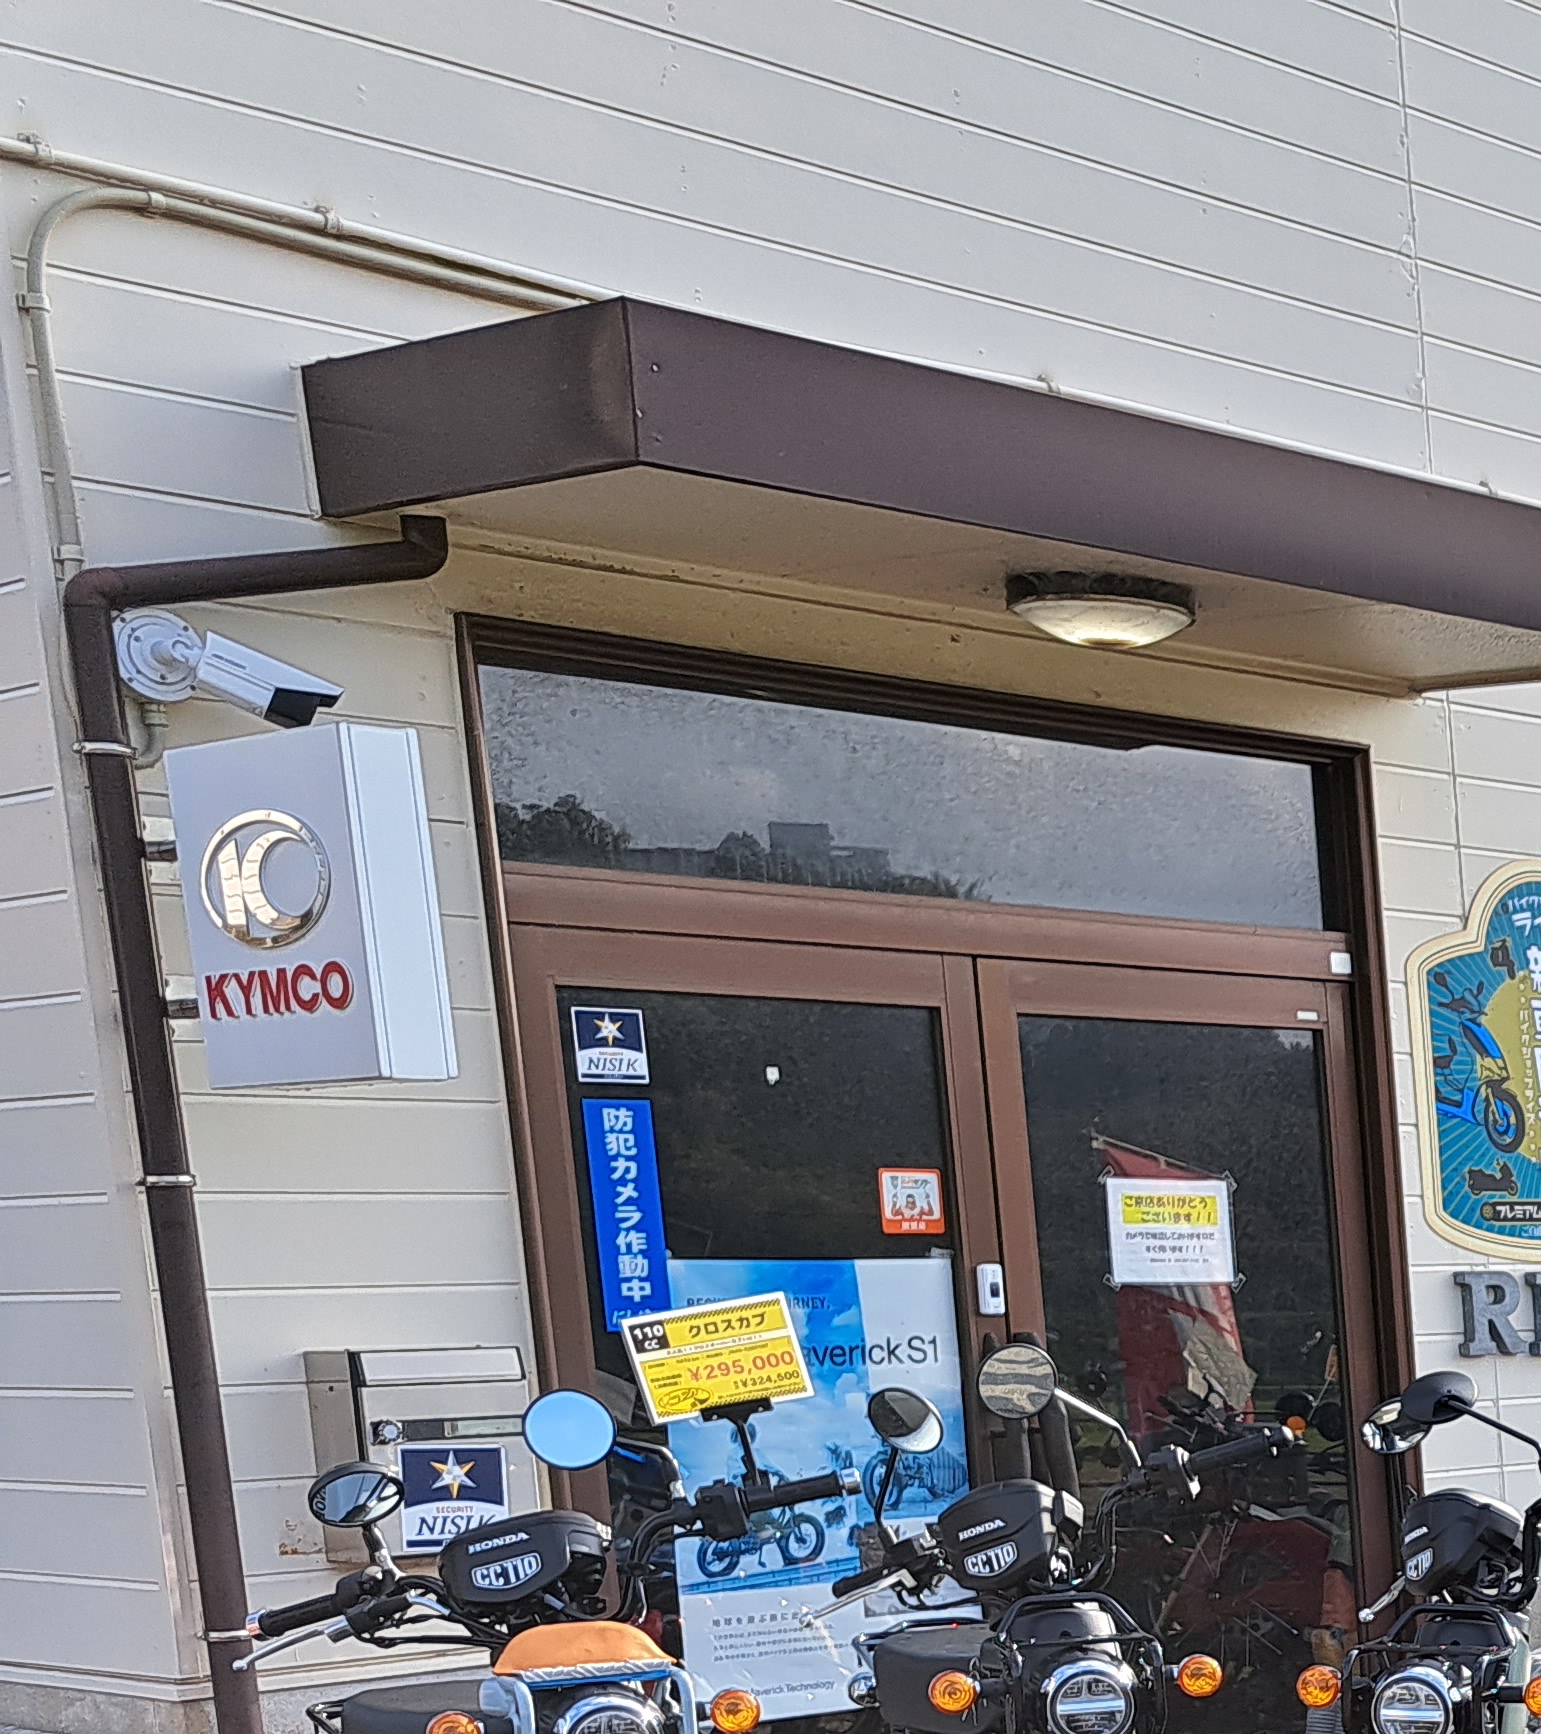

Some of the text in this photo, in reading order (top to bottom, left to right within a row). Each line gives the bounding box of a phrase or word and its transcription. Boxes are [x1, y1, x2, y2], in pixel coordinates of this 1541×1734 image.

[204, 959, 354, 1021] KYMCO
[586, 1056, 639, 1073] NISIK
[601, 1106, 653, 1303] 防犯カメラ作動中
[633, 1323, 664, 1342] 110
[687, 1310, 767, 1339] クロスカブ
[643, 1338, 661, 1350] CC
[802, 1337, 902, 1367] averick
[906, 1334, 940, 1365] S1
[686, 1350, 795, 1383] ¥295,000
[435, 1505, 475, 1514] SECURITY
[467, 1531, 531, 1555] HONDA
[958, 1518, 1006, 1542] HONDA
[474, 1555, 538, 1587] CC110
[966, 1544, 1015, 1574] CC110
[786, 1679, 836, 1692] Technology
